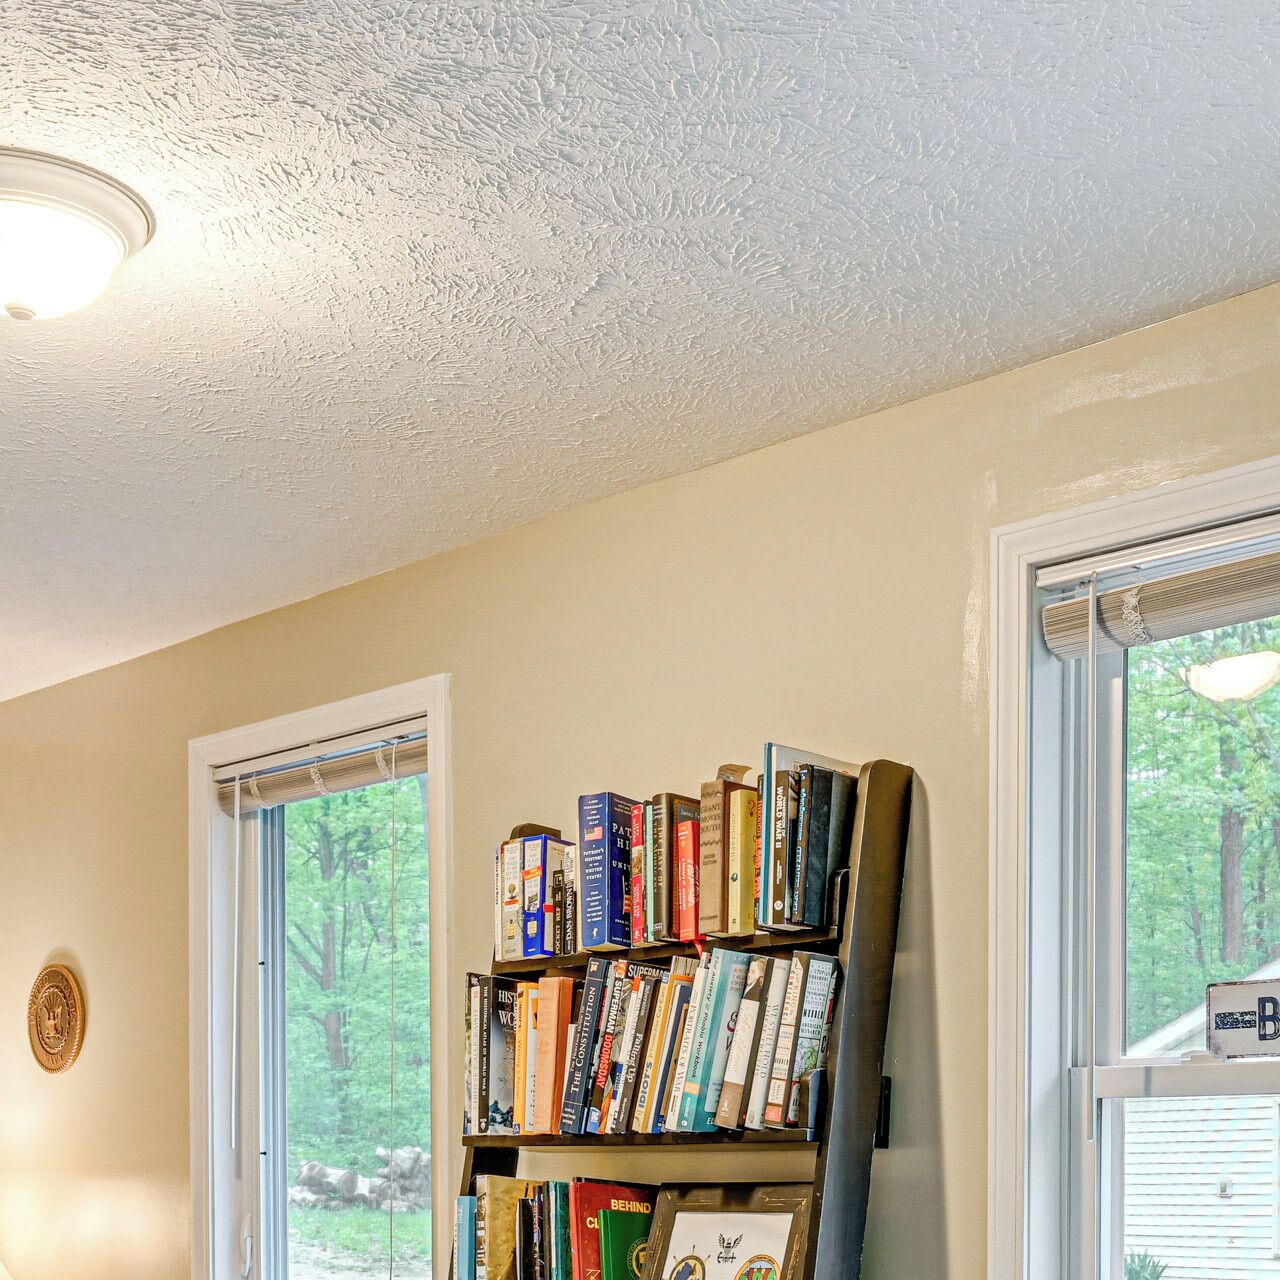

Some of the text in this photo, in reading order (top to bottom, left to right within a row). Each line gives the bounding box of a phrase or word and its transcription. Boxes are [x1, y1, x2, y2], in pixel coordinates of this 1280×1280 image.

[775, 786, 783, 818] WORLD
[705, 970, 717, 1001] Anxiety
[569, 1069, 582, 1094] THE
[576, 986, 596, 1067] CONSTITUTION
[596, 979, 623, 1088] SUPERMAN DOOMSDAY
[625, 984, 650, 1083] Silverstein Falling Up
[680, 1004, 696, 1055] PORTRAITS
[698, 1011, 709, 1038] Phobia
[482, 1047, 487, 1055] OF
[758, 1003, 779, 1079] WE STILL HOLD
[677, 1056, 686, 1069] OF
[690, 1040, 703, 1078] Workbook
[673, 1070, 684, 1093] WAR
[610, 1199, 651, 1214] BEHIND
[586, 1216, 599, 1229] CL
